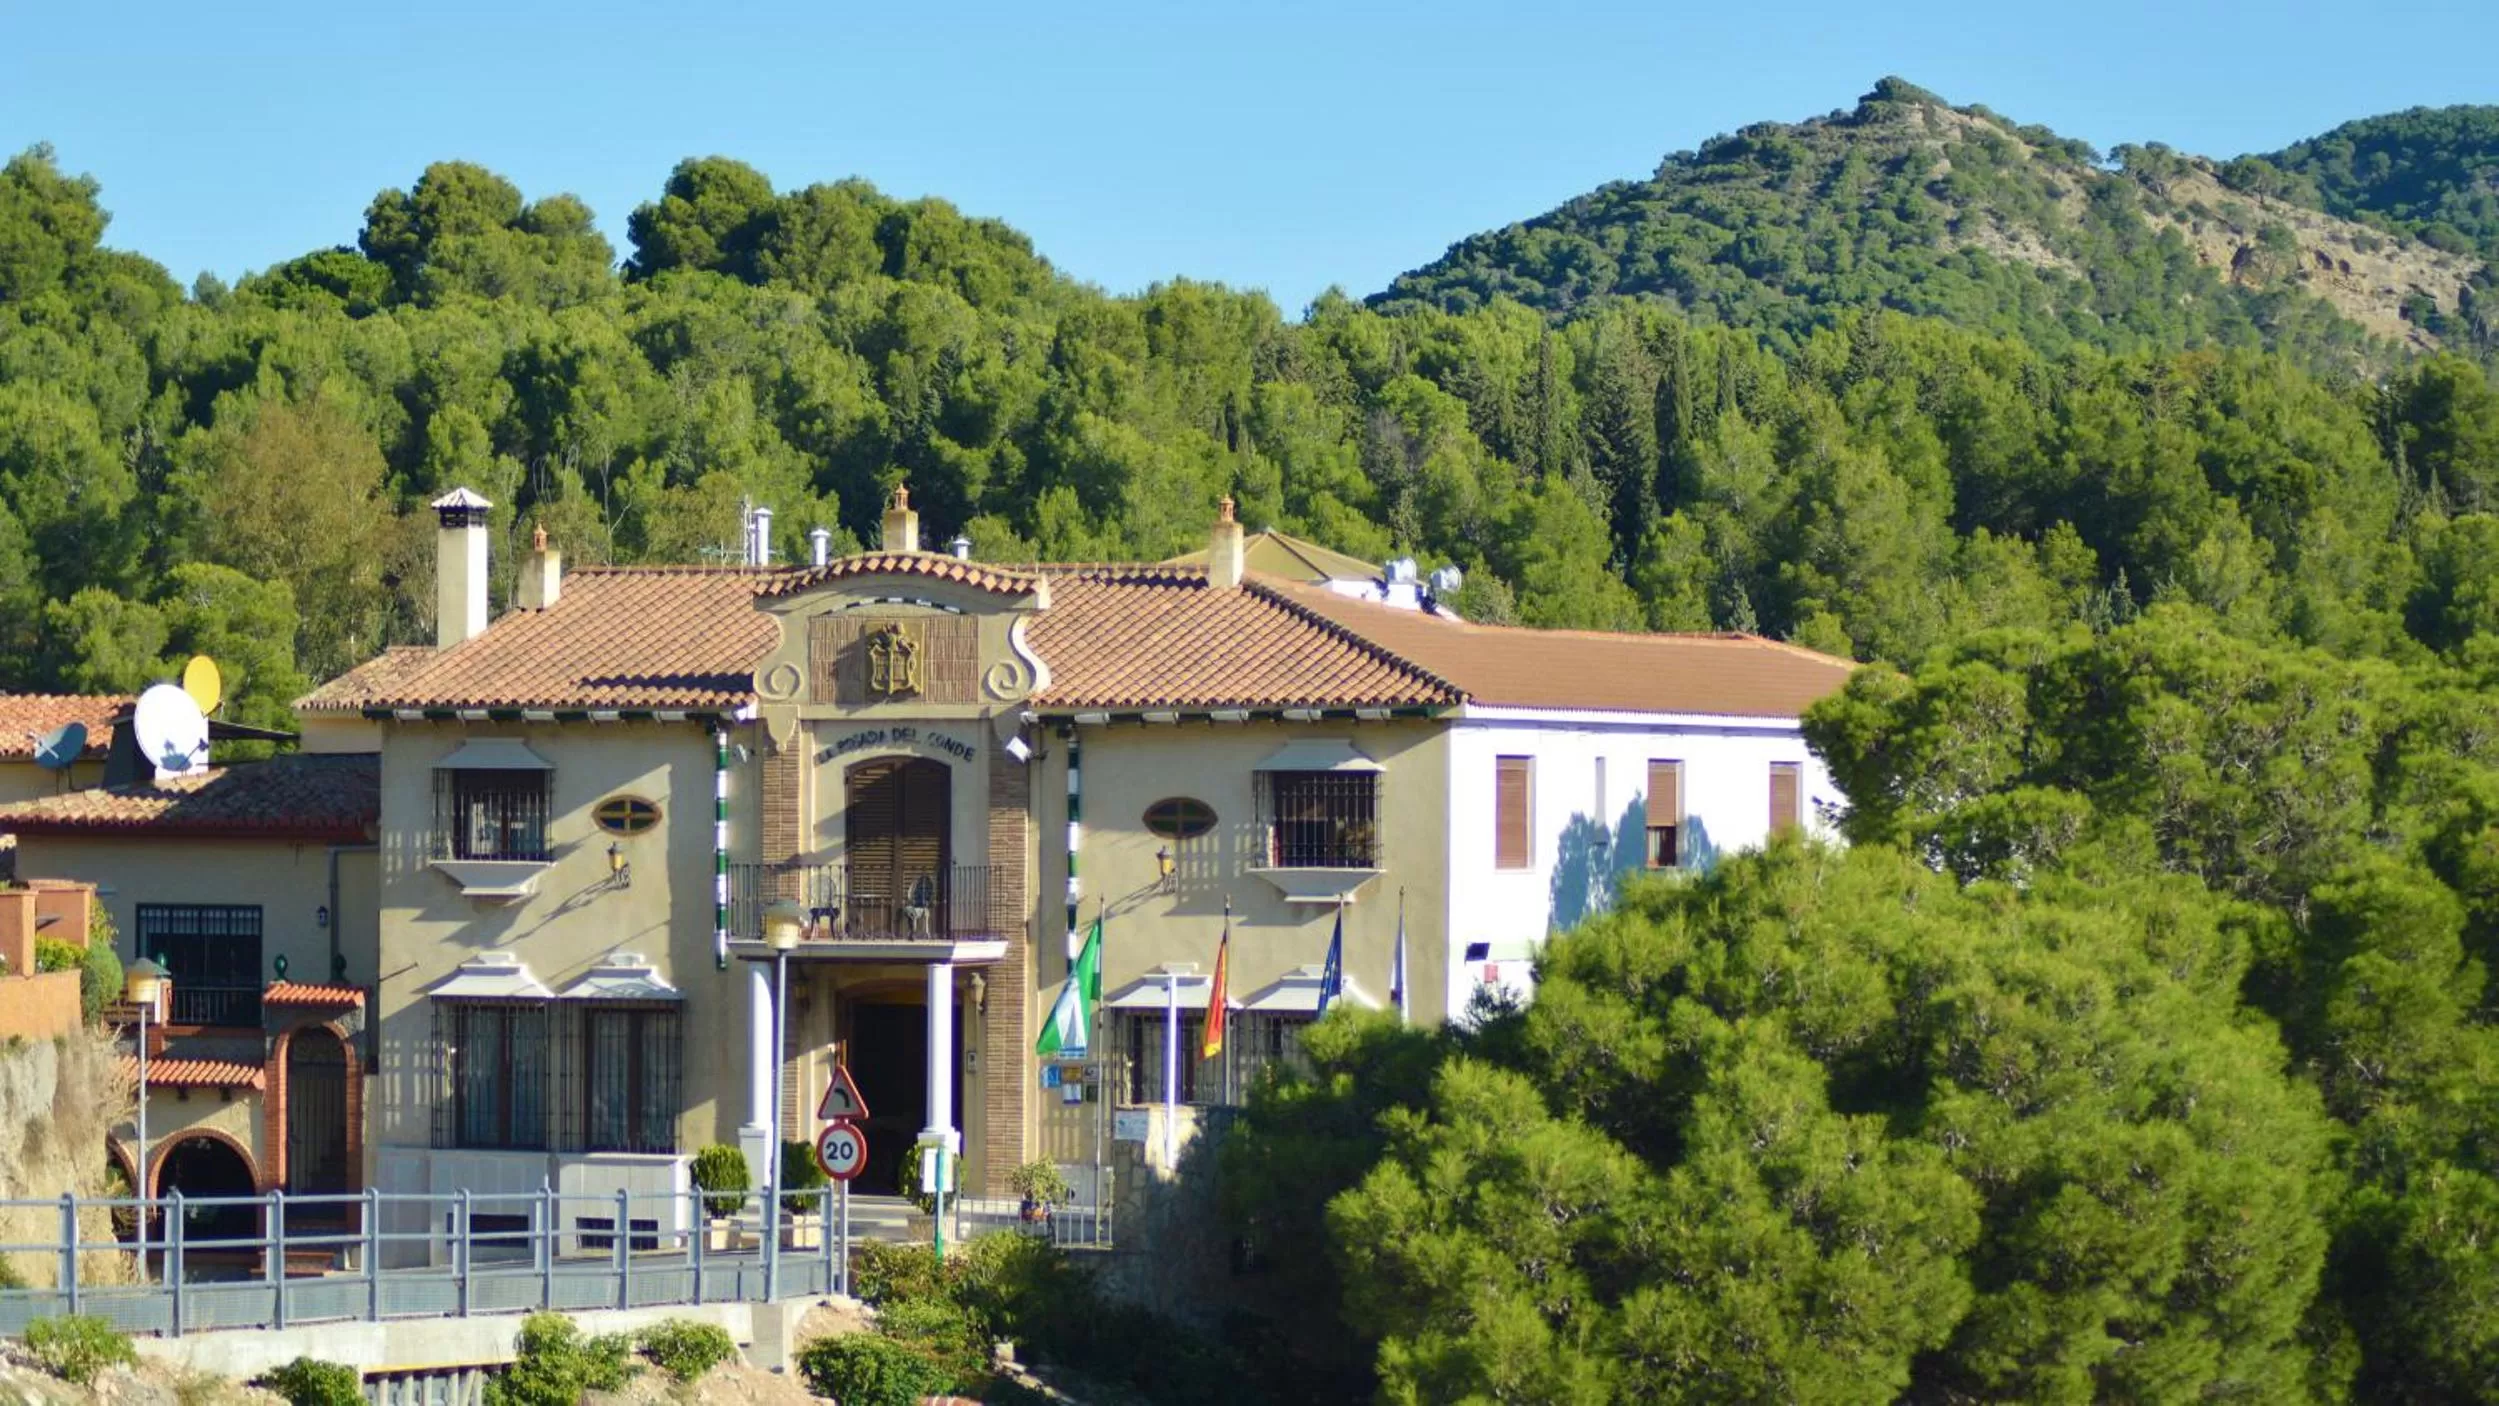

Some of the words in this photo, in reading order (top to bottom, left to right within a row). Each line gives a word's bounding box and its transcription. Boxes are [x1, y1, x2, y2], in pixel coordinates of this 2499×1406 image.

[892, 727, 917, 742] DEL
[927, 732, 976, 762] CONDE
[826, 1141, 853, 1160] 20
